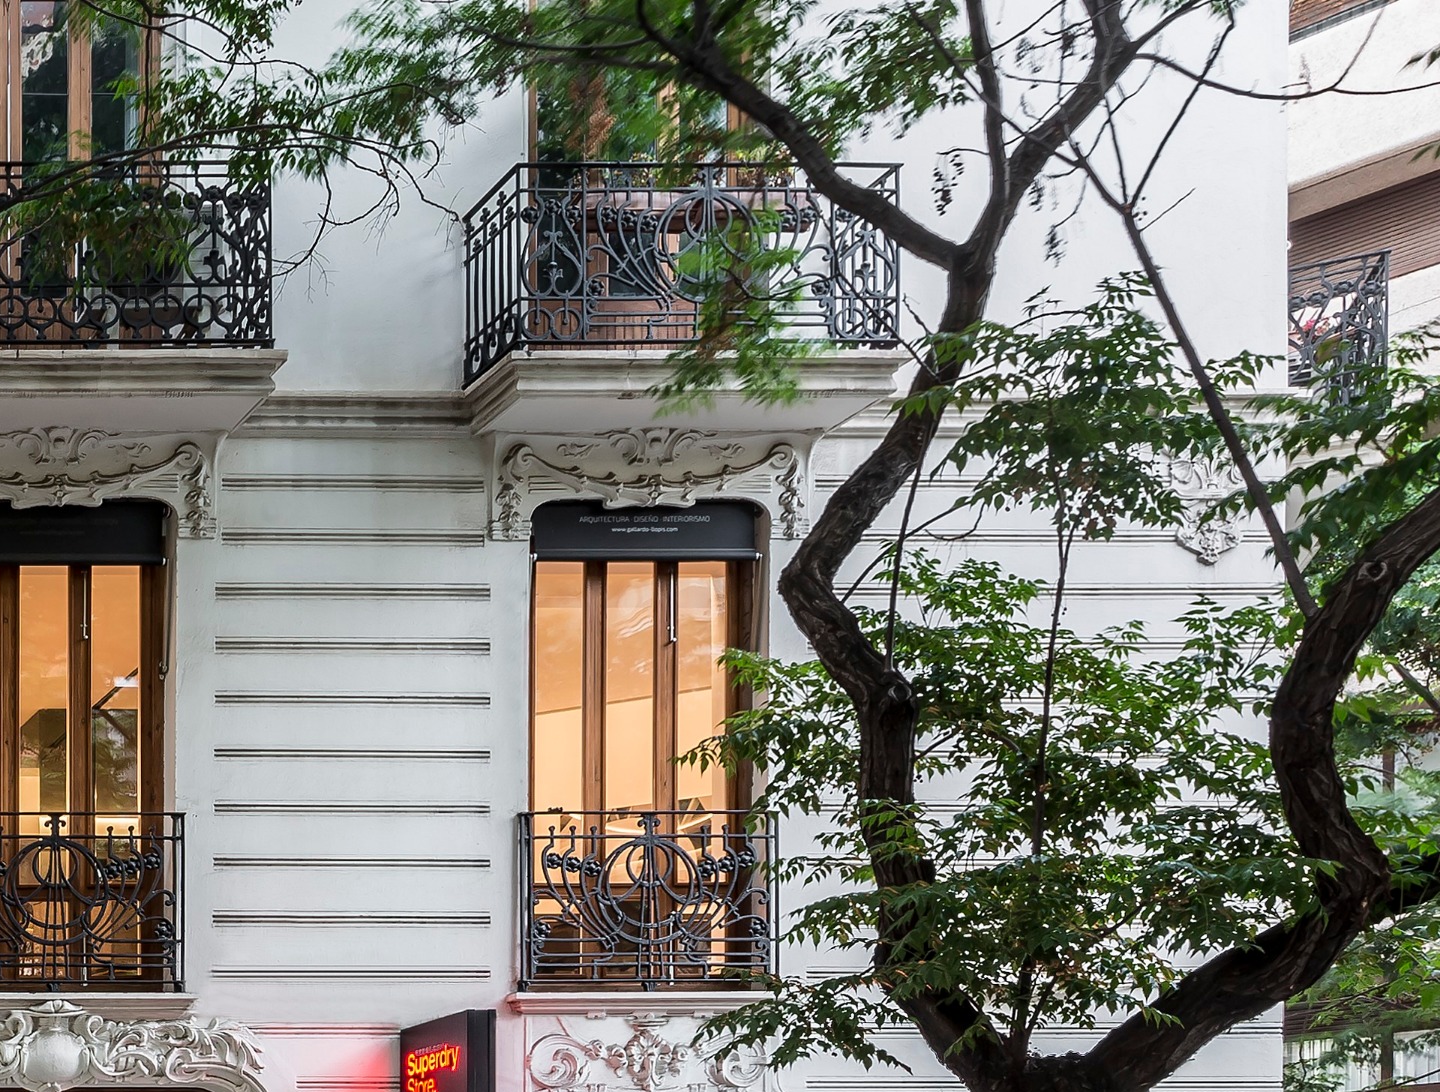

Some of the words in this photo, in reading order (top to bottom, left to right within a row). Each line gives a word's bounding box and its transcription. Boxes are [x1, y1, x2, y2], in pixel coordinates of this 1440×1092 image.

[579, 515, 630, 523] ARQUITECTURA
[633, 514, 659, 523] DISEÑO
[662, 515, 711, 523] INTERIORISMO
[407, 1043, 460, 1078] Superdry
